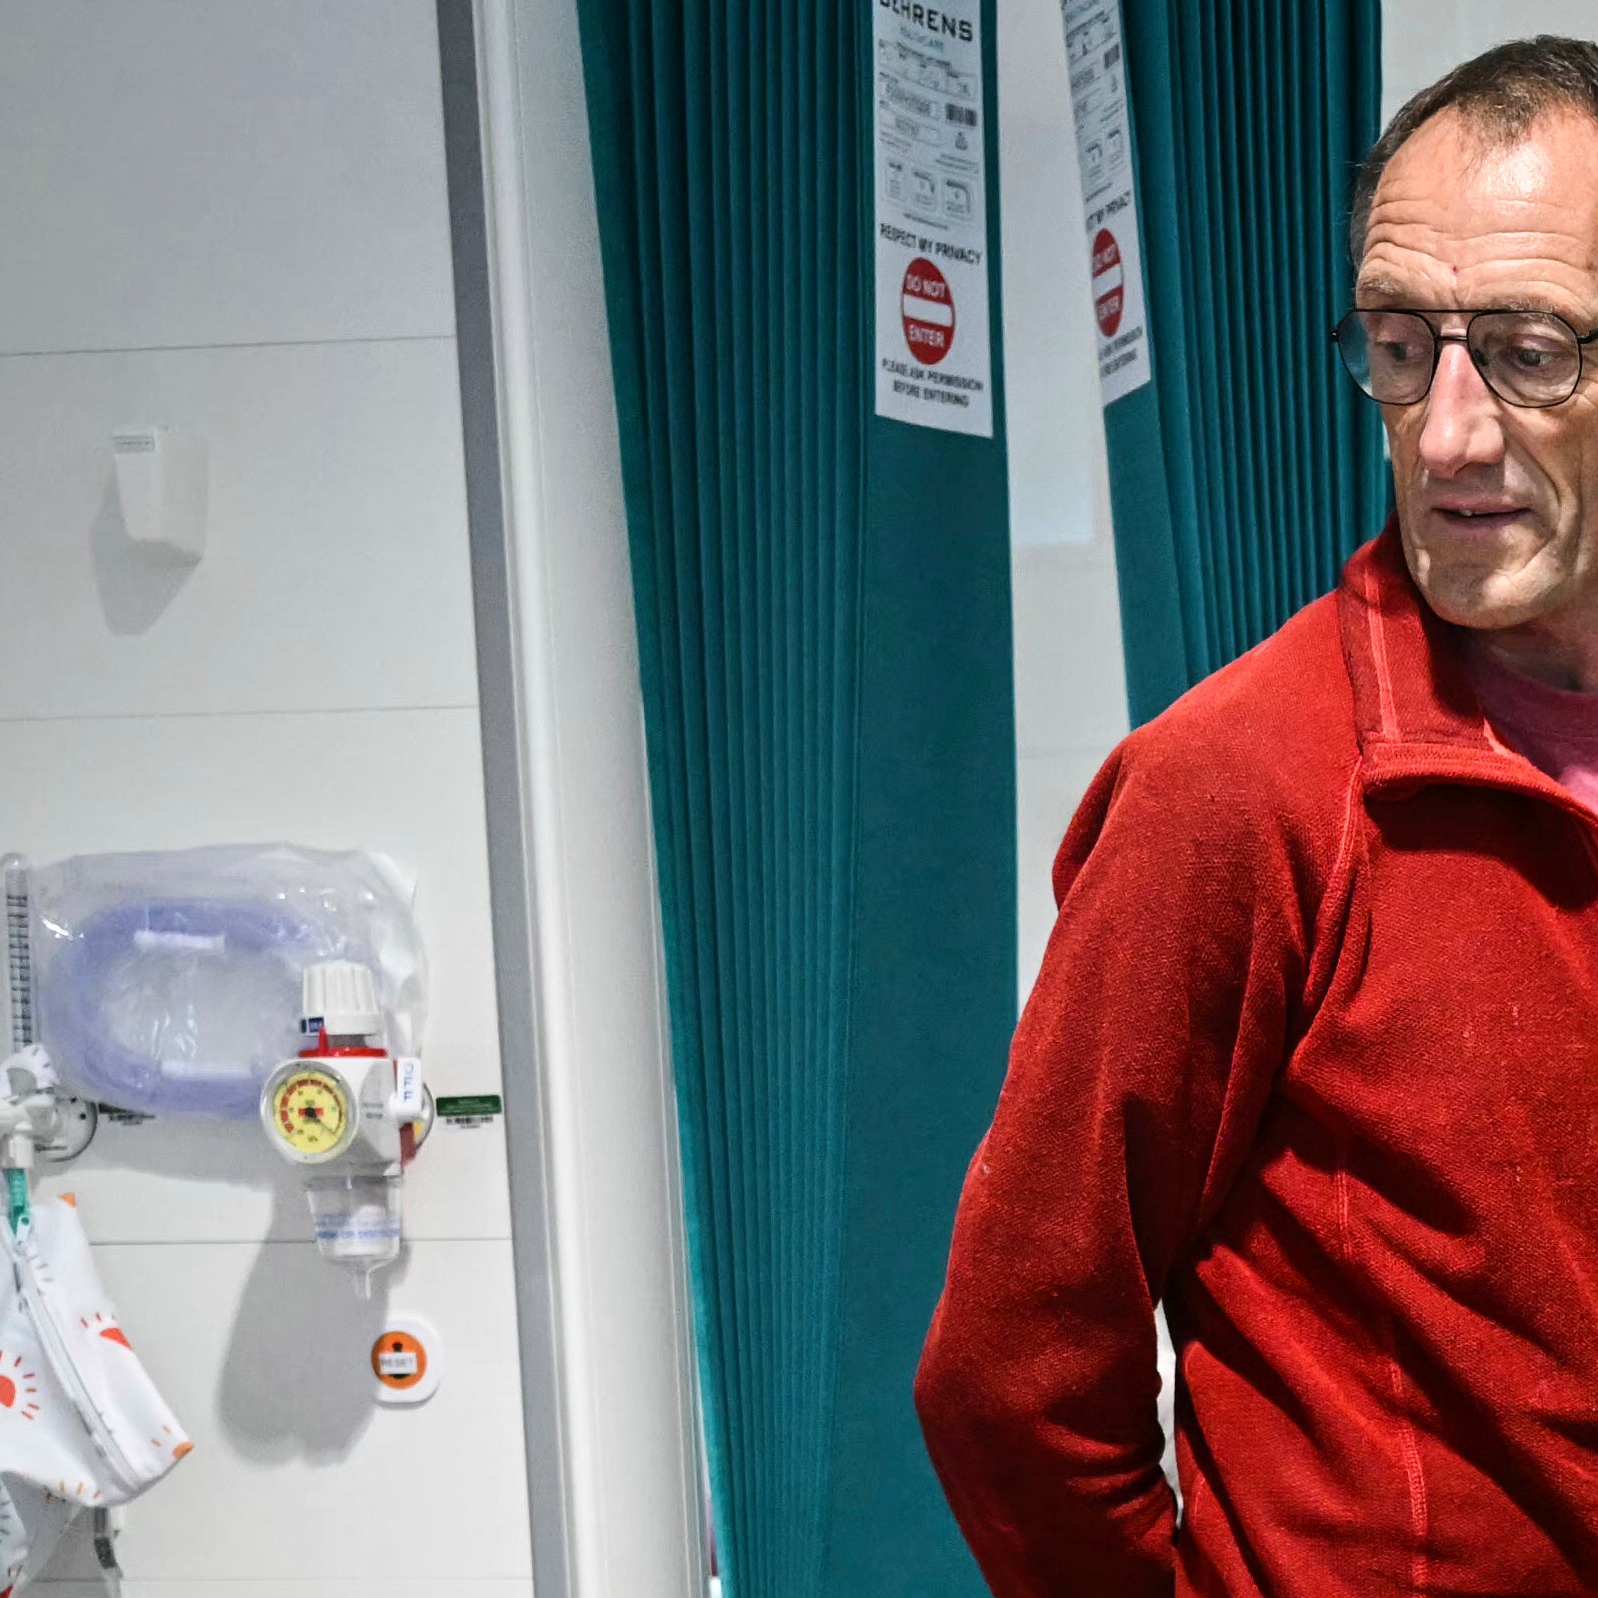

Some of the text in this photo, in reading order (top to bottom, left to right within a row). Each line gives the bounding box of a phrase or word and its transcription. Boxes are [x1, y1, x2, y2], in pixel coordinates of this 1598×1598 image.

[879, 223, 981, 265] RESPECT MY PRIVACY
[906, 273, 945, 298] DO NOT
[908, 324, 944, 348] ENTER
